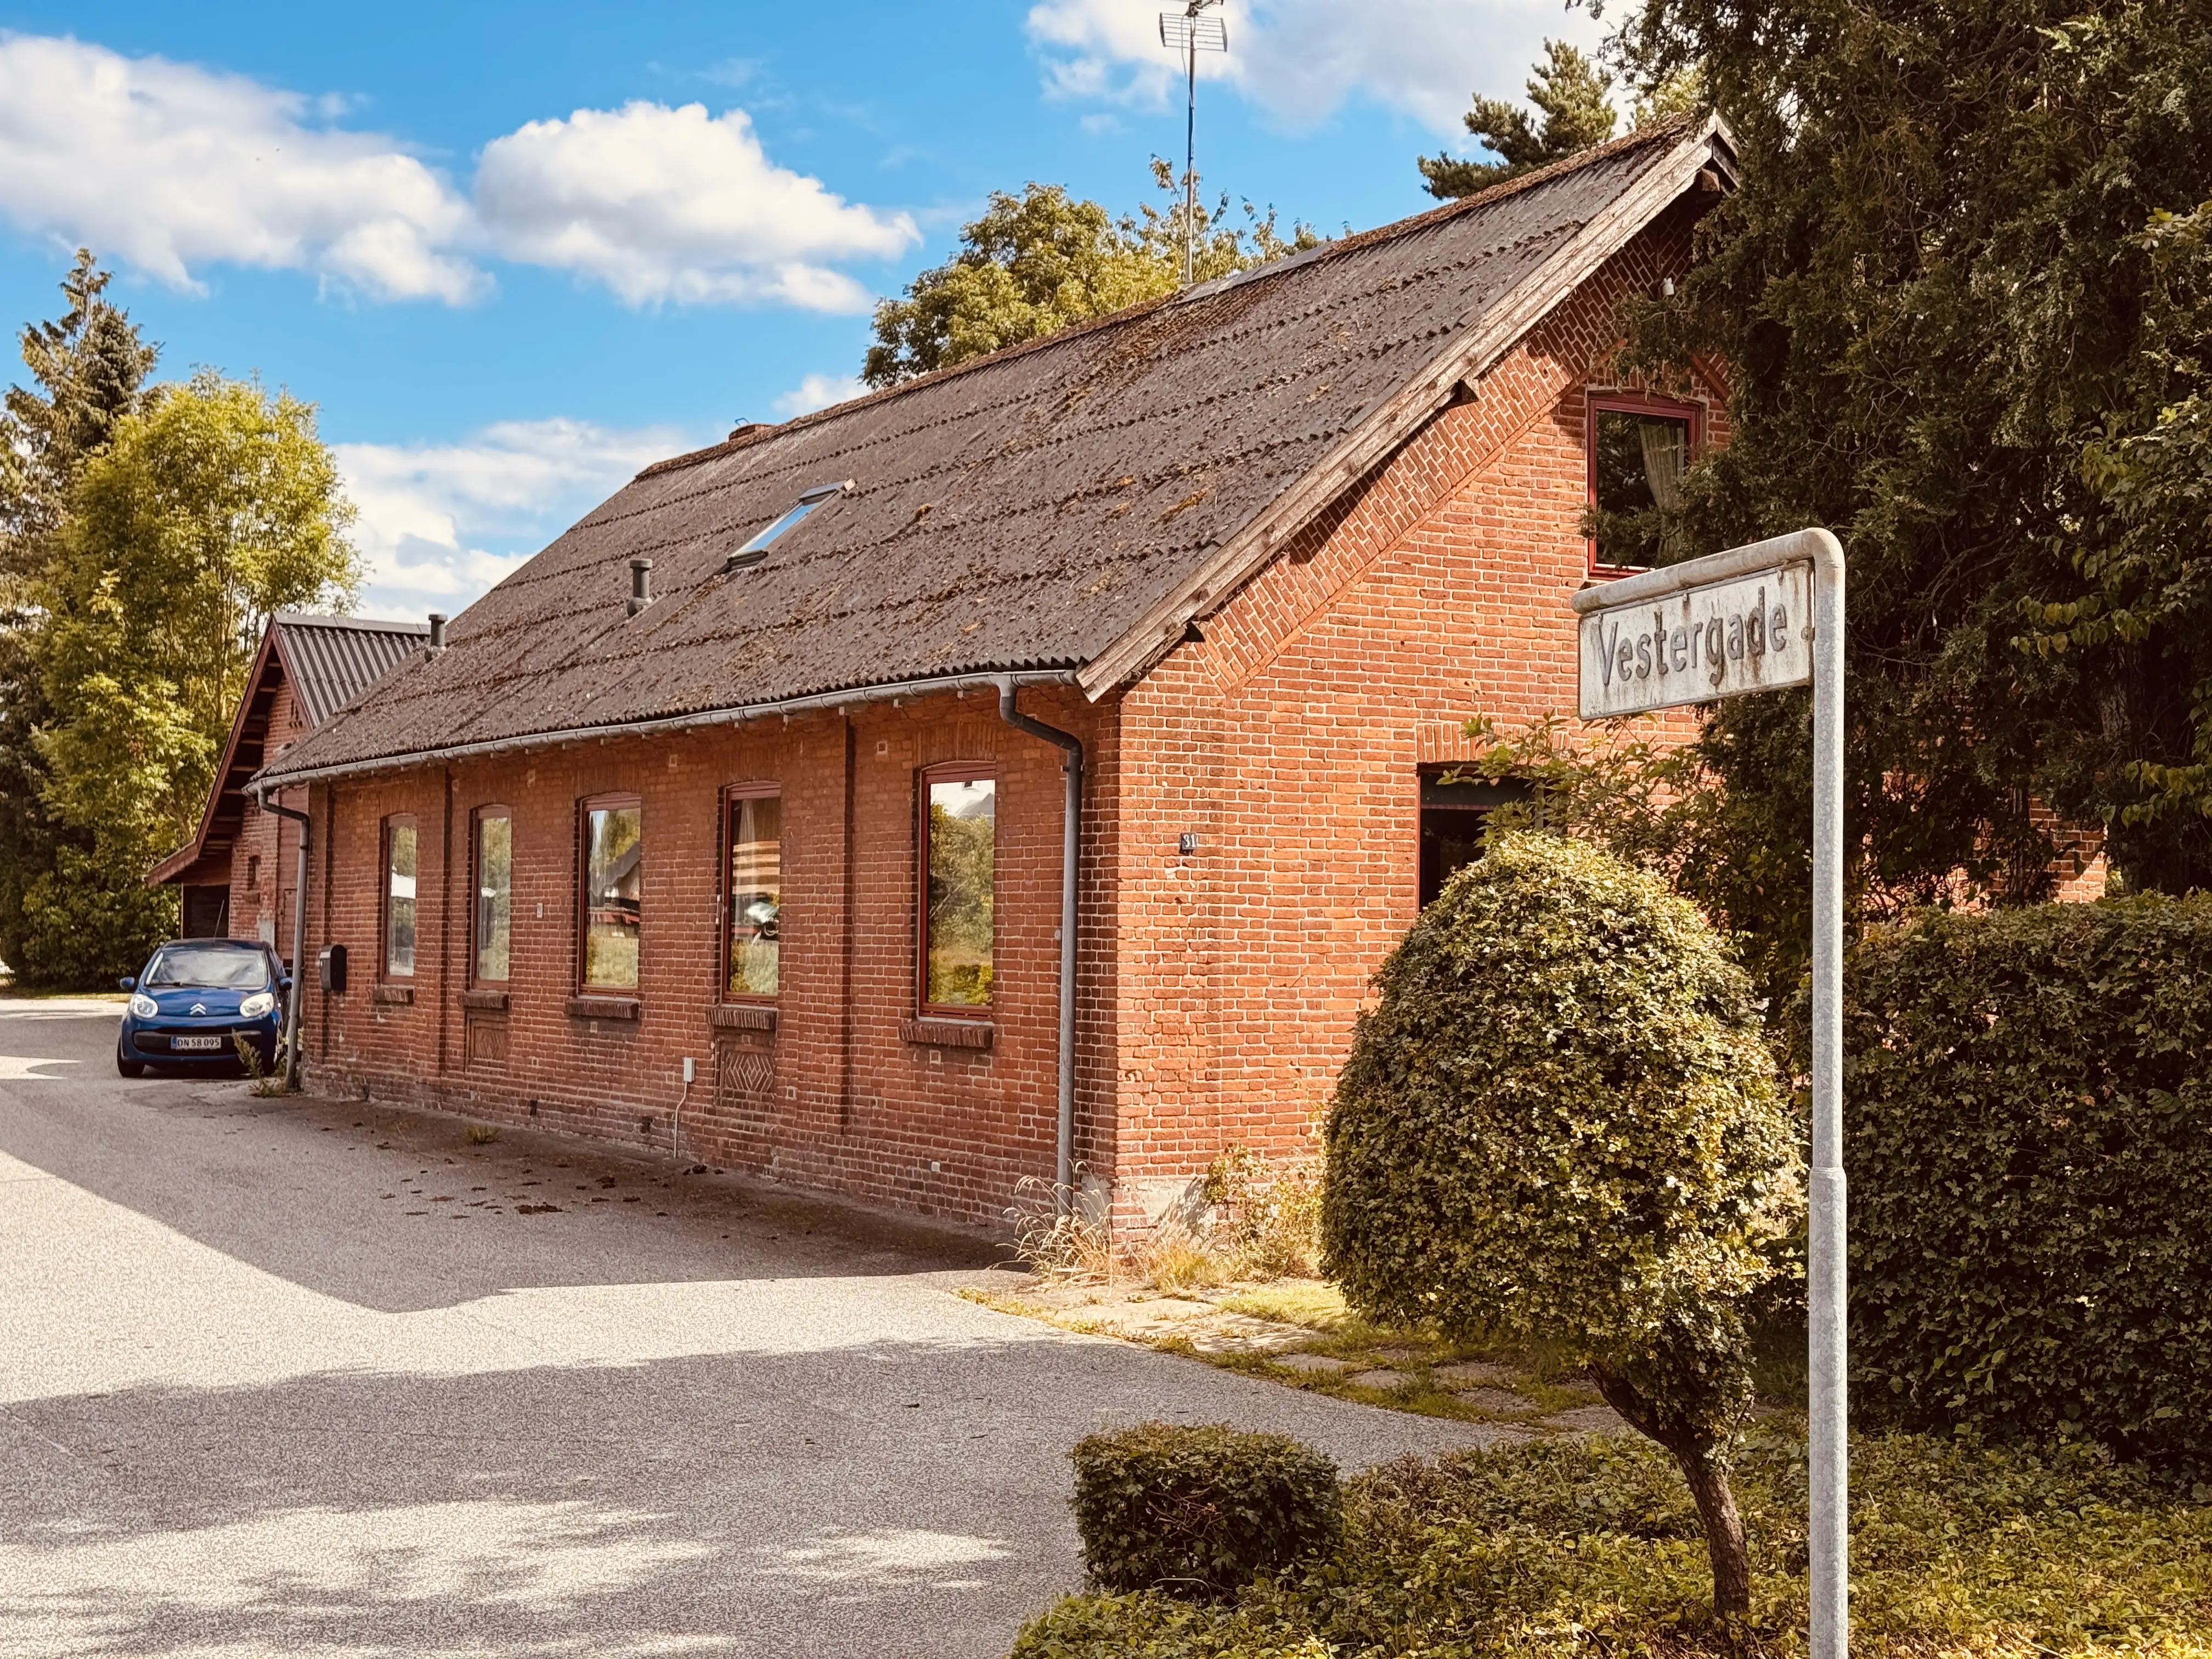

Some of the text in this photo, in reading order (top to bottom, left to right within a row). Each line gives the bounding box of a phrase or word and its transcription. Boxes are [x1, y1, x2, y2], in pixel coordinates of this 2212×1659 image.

[1598, 585, 1787, 686] Vestergade
[1183, 833, 1197, 848] 31
[177, 1039, 189, 1047] DN
